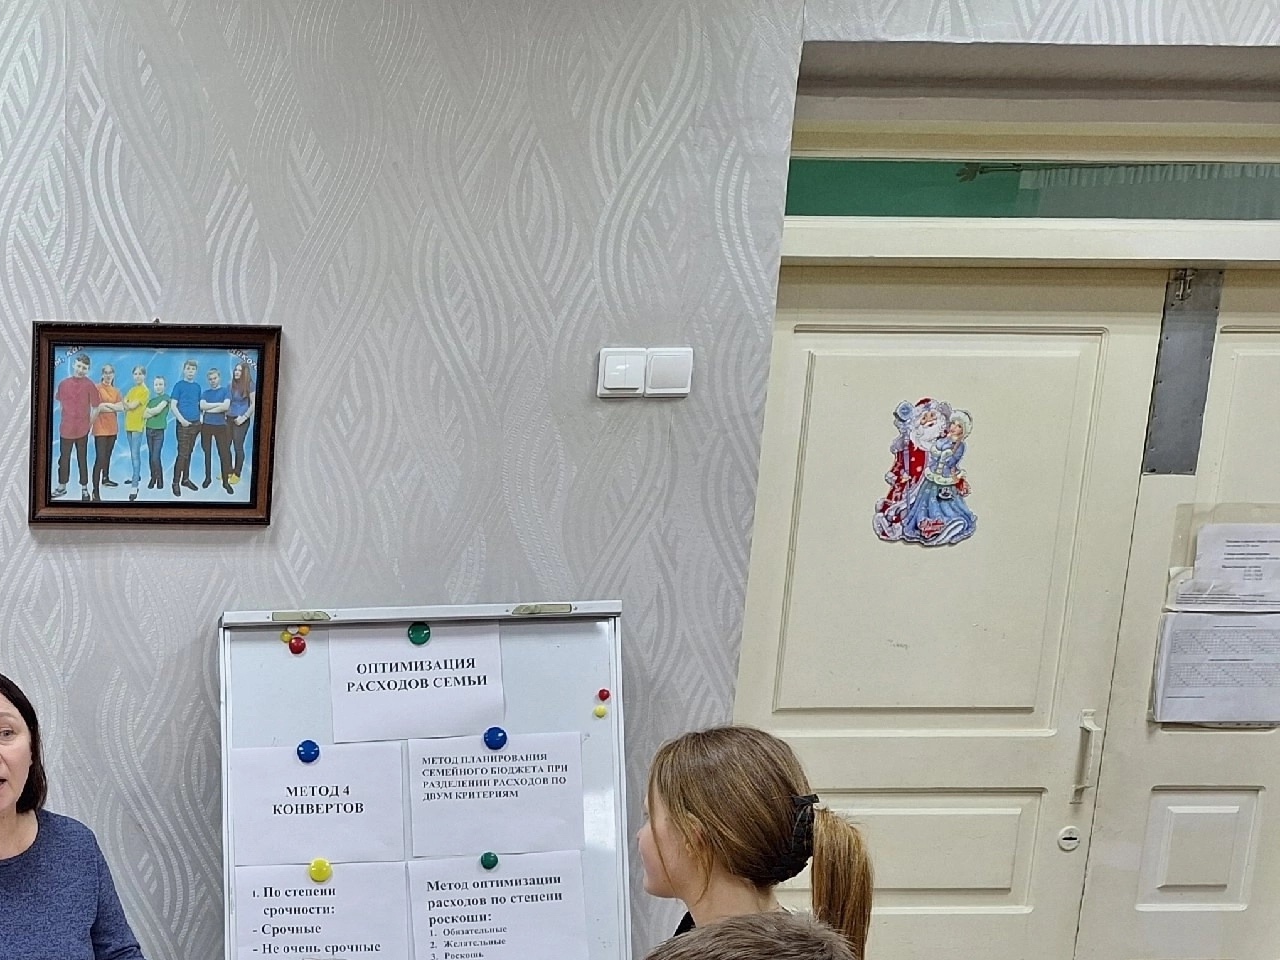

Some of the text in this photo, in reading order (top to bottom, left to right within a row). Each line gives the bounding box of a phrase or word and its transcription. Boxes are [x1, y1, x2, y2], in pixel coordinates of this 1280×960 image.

[356, 658, 477, 676] ОПТИМИЗАЦИЯ
[347, 674, 488, 693] РАСХОДОВ СЕМЬИ
[422, 753, 548, 765] МЕТОД ПЛАНИРОВАНИЯ
[422, 764, 568, 777] СЕМЕЙНОГО БЮДЖЕТА ПРИ
[423, 776, 567, 789] РАЗДЕЛЕНИИ РАСХОДОВ ПО
[285, 785, 351, 798] МЕТОД 4
[422, 790, 519, 801] ДВУМ КРИТЕРИЯМ
[272, 802, 364, 815] КОНВЕРТОВ
[426, 876, 561, 892] Метод оптимизации
[263, 886, 281, 898] По
[284, 887, 336, 898] степени
[427, 892, 563, 911] расходов по степени
[263, 904, 335, 918] срочности:
[428, 913, 492, 927] роскоши:
[261, 923, 322, 937] Срочные
[442, 926, 508, 937] Обязательные
[262, 943, 280, 954] Не
[283, 944, 321, 953] очень
[324, 943, 381, 955] срочные
[443, 938, 507, 948] Желательные
[444, 951, 485, 960] Роскошь
